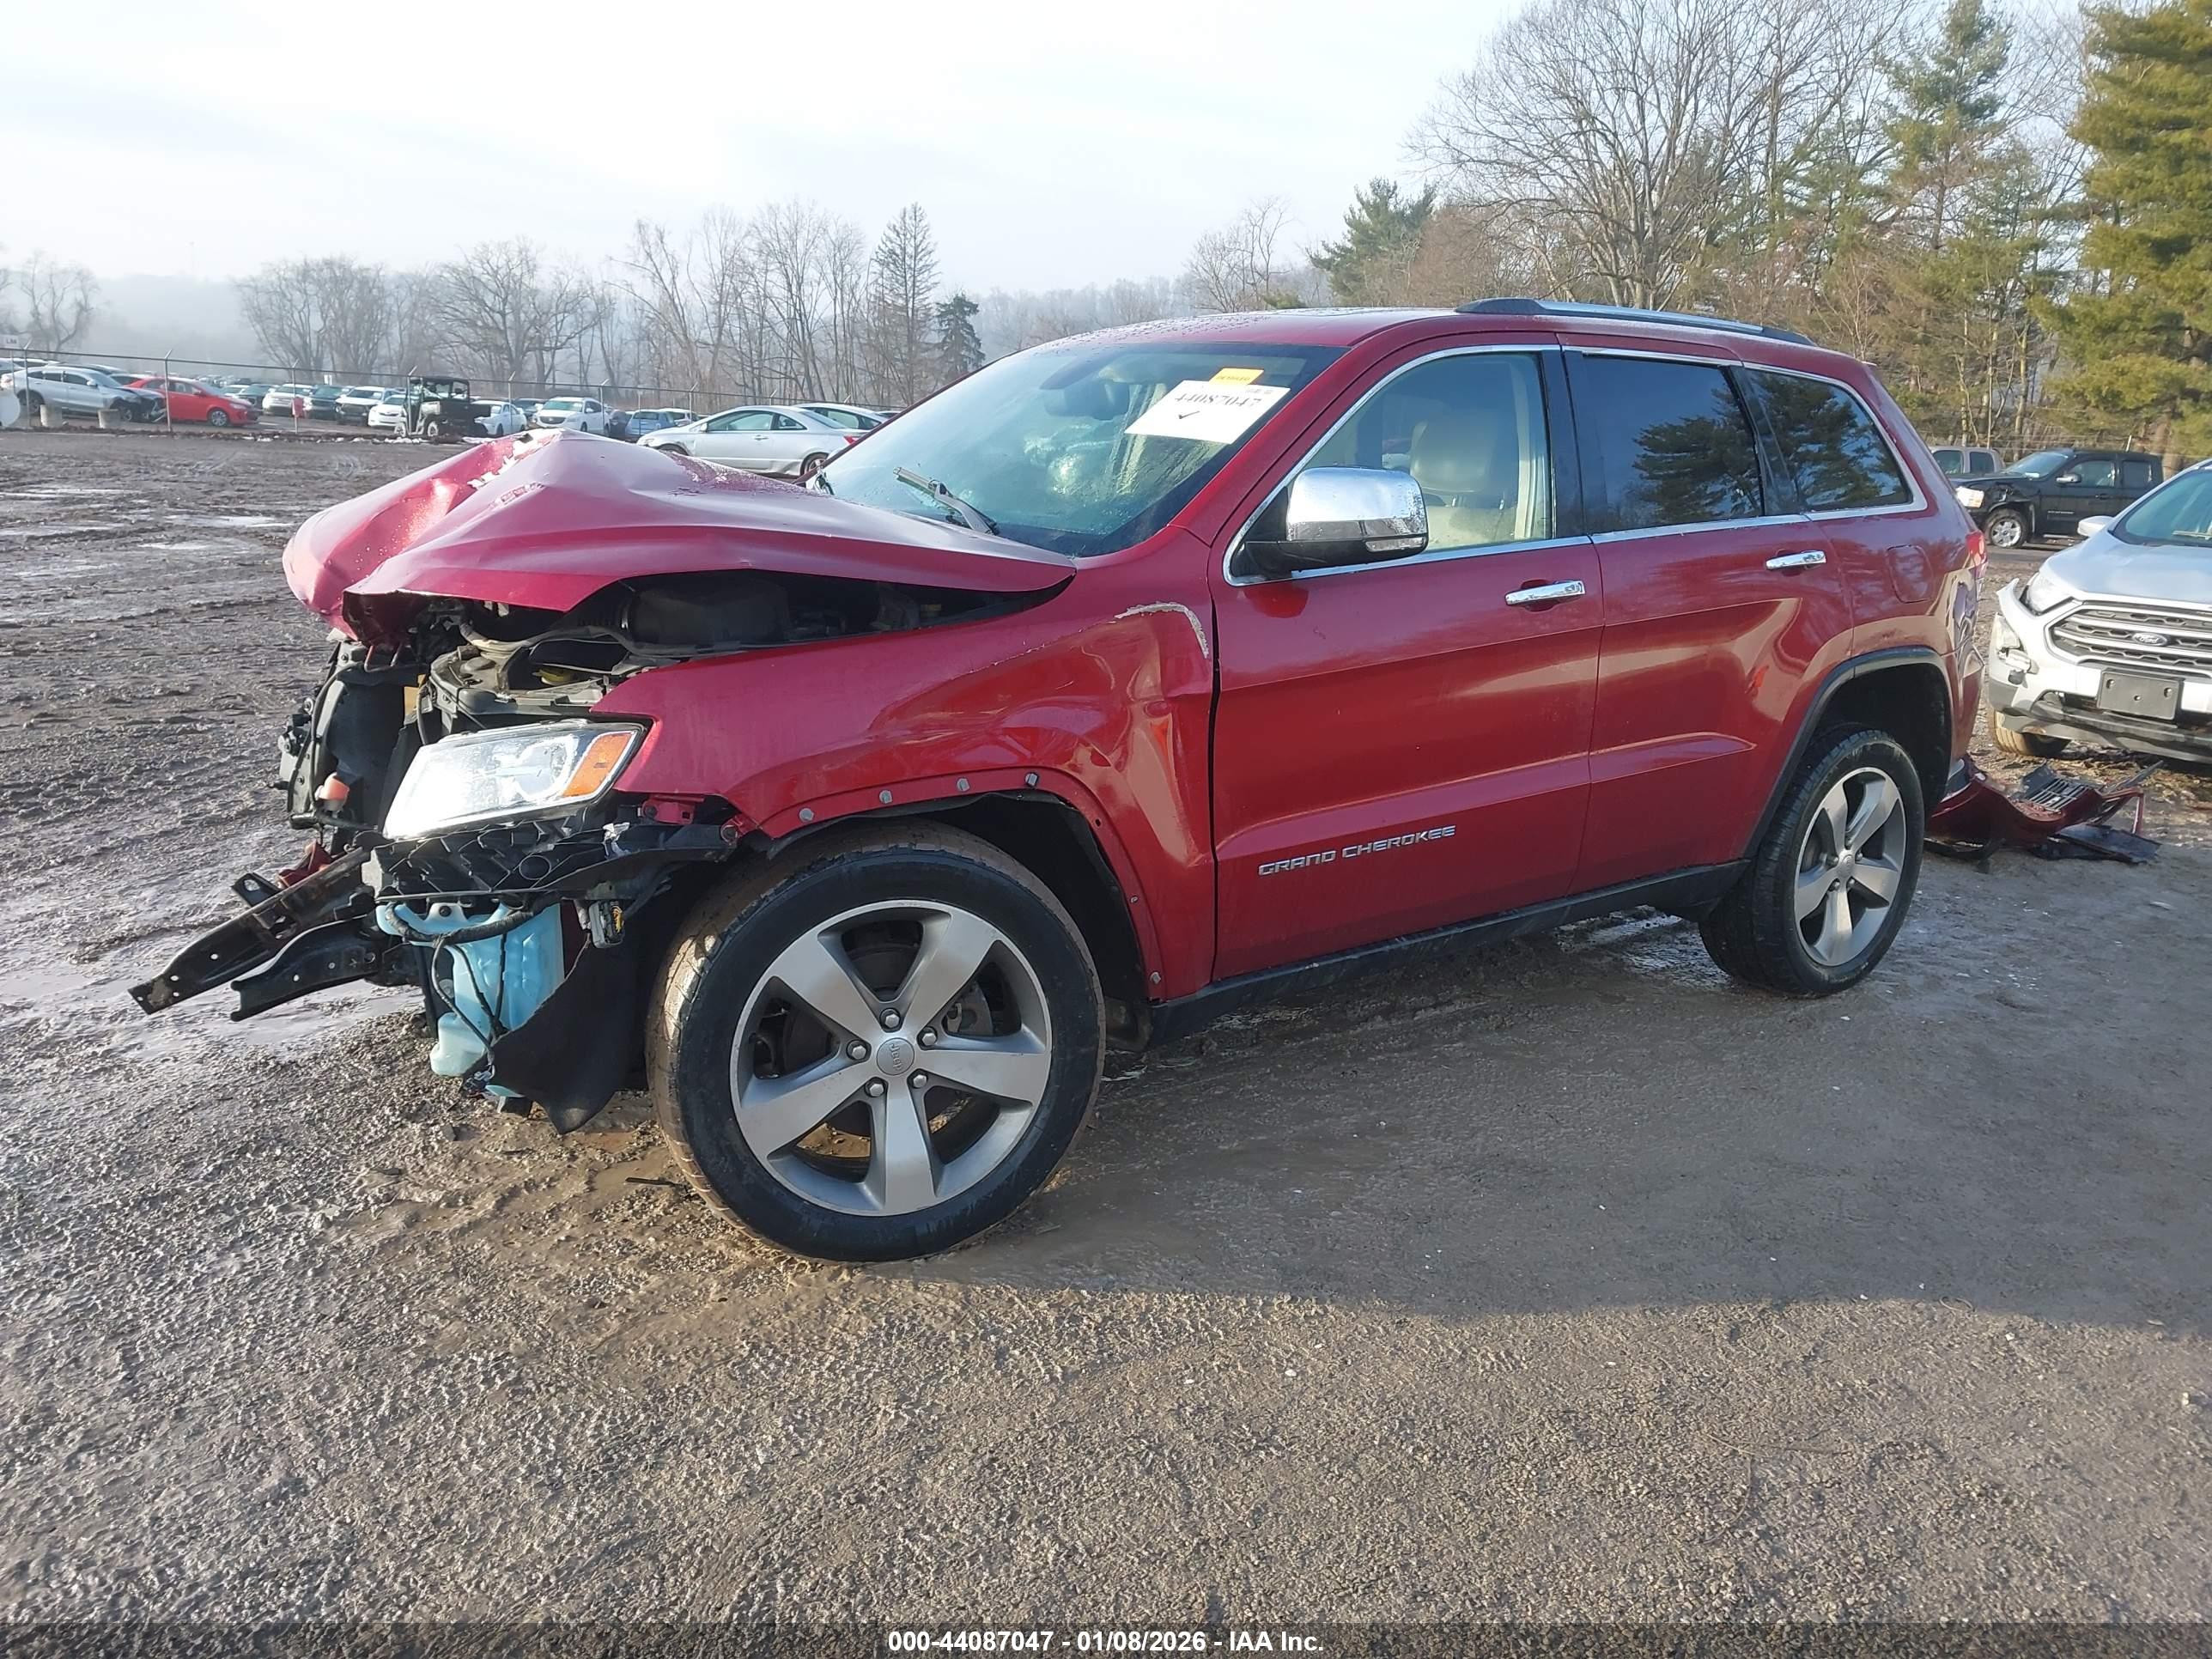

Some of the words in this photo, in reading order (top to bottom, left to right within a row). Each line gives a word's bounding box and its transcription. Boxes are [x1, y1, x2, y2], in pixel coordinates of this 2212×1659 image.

[1258, 850, 1337, 876] GRAND
[1341, 824, 1456, 859] CHEROKEE
[890, 1042, 902, 1072] Jeep
